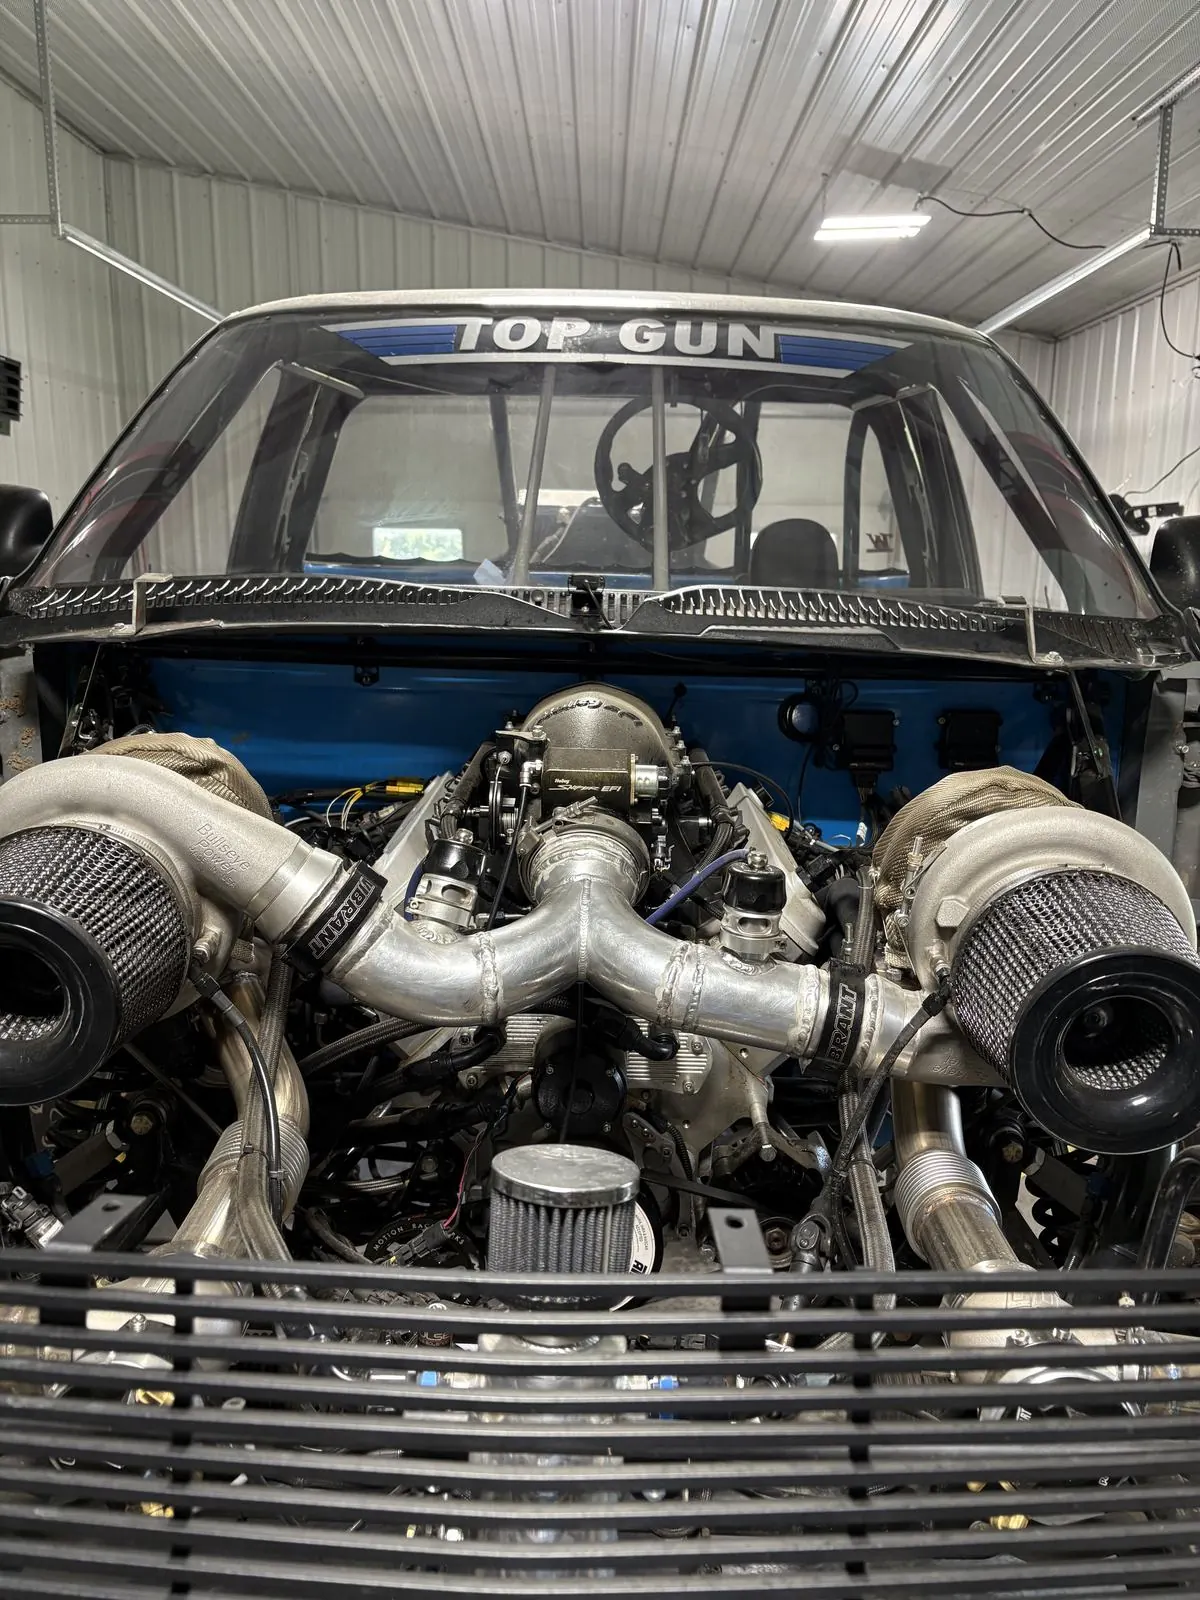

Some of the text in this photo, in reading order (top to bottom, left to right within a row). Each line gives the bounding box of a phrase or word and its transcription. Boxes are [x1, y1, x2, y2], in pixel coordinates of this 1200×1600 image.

[456, 315, 778, 360] TOP GUN
[193, 838, 237, 874] Power
[196, 822, 251, 872] Bullseye
[307, 874, 376, 960] VIBRANT
[372, 1226, 405, 1252] MOTION
